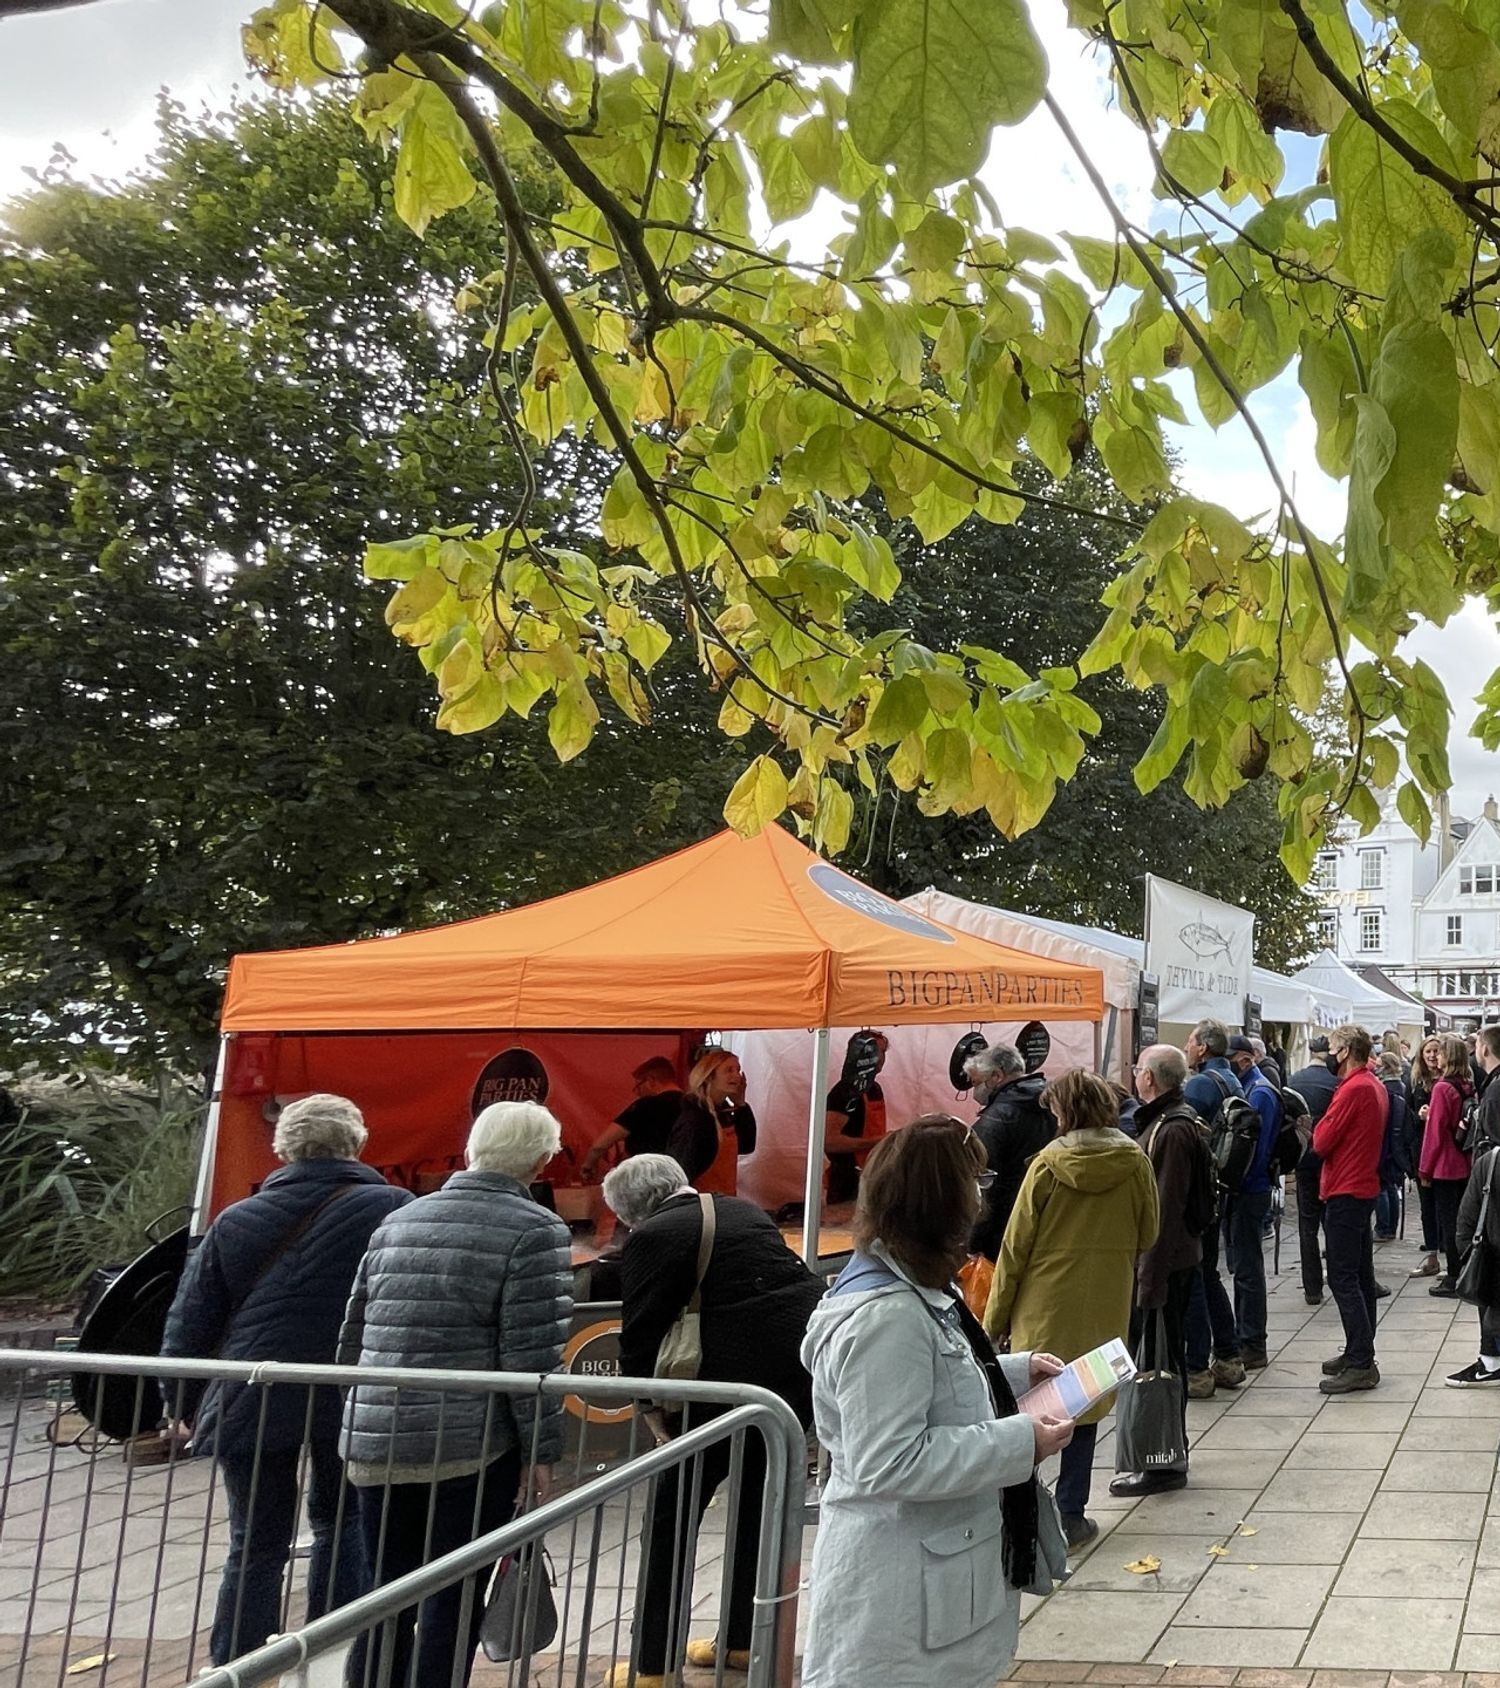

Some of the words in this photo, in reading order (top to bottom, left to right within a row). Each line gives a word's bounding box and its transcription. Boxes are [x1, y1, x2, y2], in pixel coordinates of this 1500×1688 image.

[1166, 964, 1204, 992] THYME
[1207, 972, 1215, 993] &
[1218, 974, 1239, 996] TIDE
[483, 1078, 506, 1092] BIG
[508, 1077, 541, 1090] PAN
[582, 1360, 610, 1372] BIG
